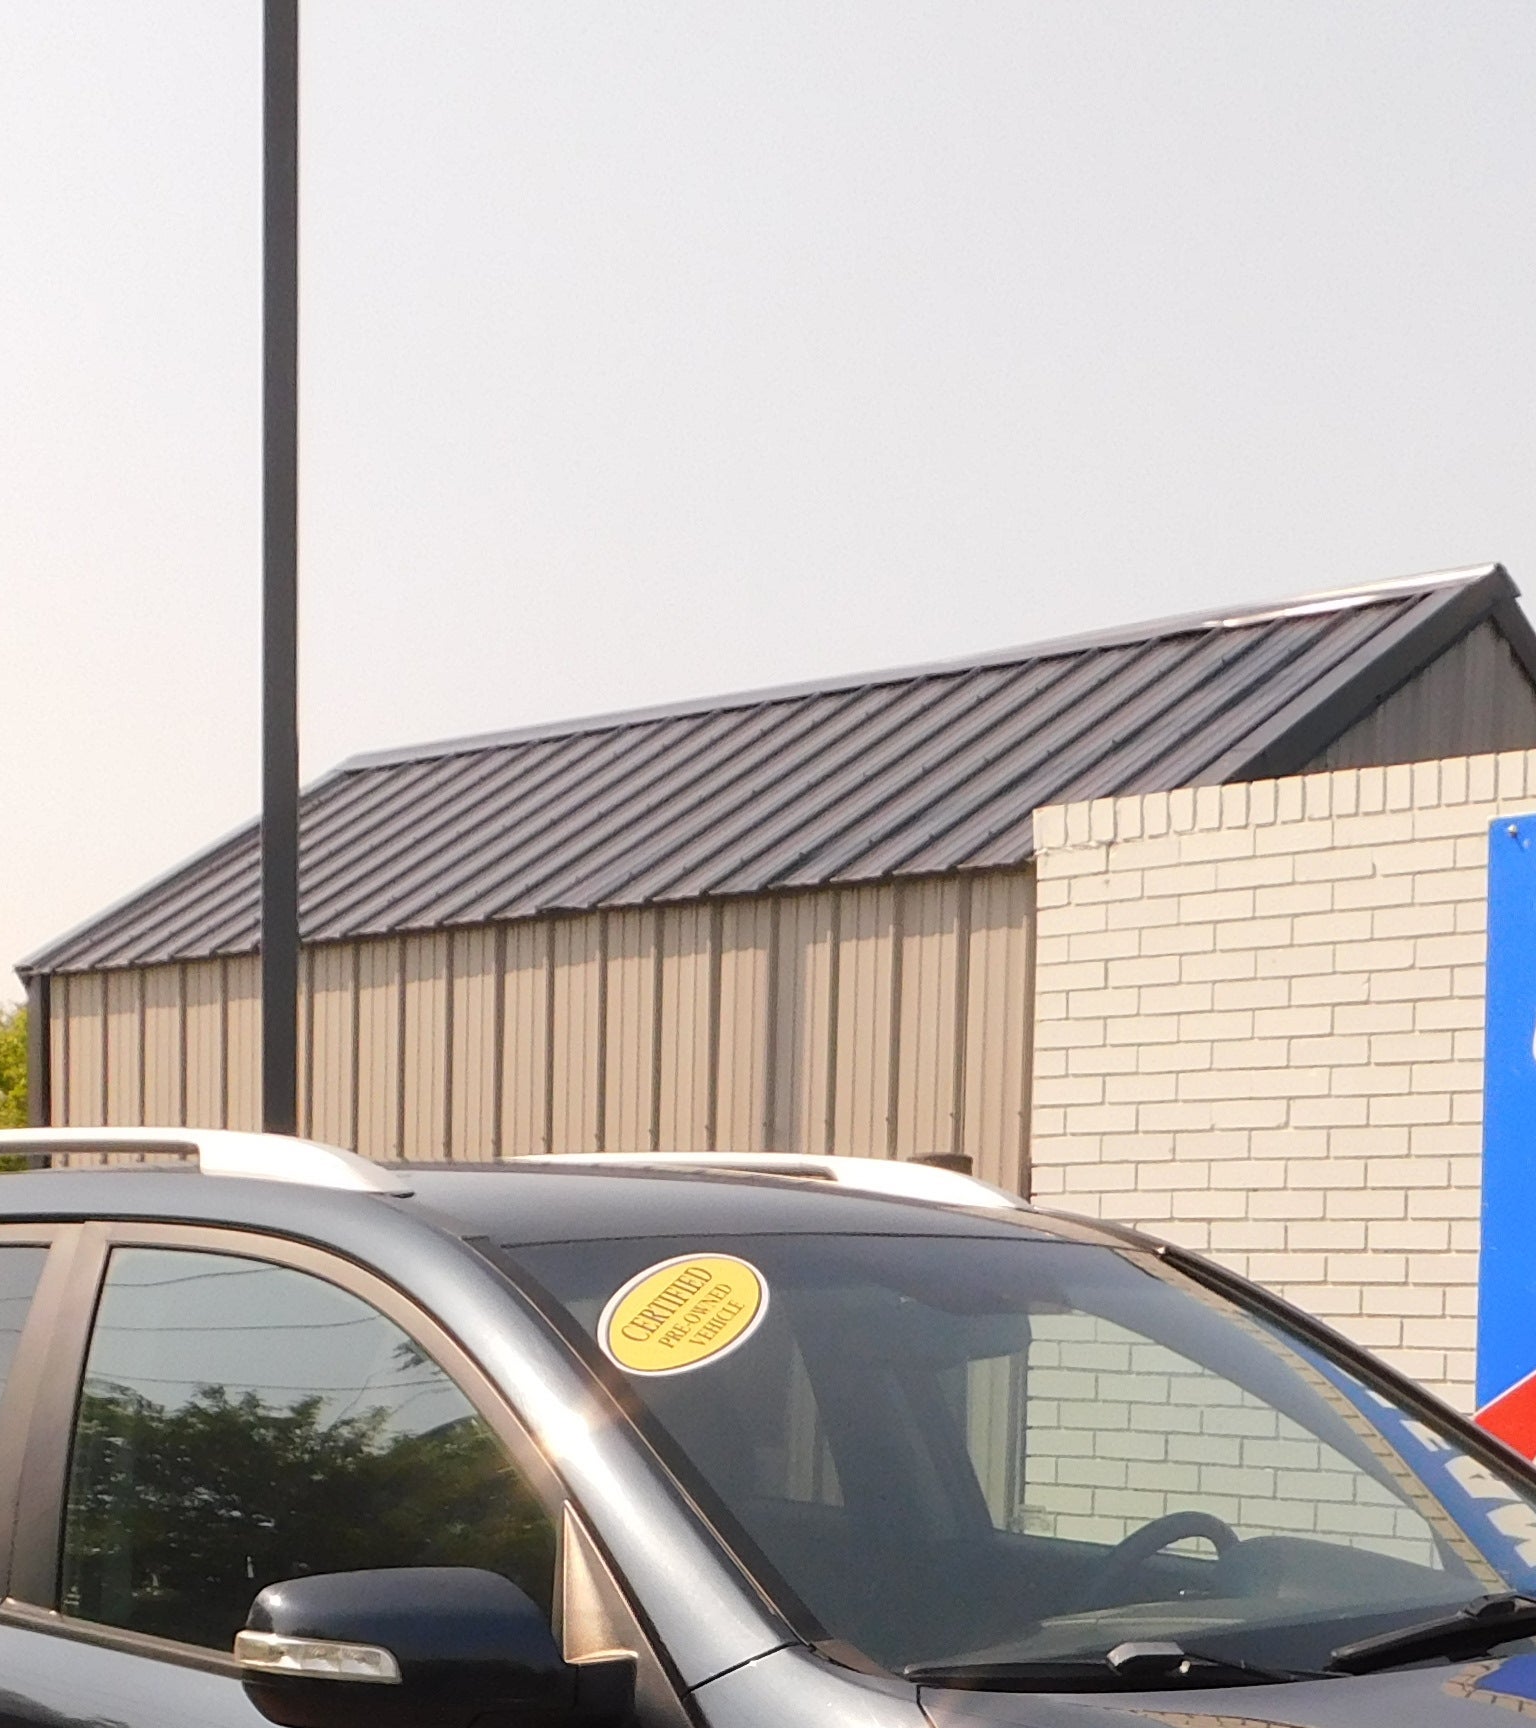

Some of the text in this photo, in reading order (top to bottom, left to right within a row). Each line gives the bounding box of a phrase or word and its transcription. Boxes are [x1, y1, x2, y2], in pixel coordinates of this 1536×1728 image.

[621, 1266, 713, 1342] CERTIFIED
[658, 1283, 732, 1349] PRE-OWNED
[688, 1300, 745, 1347] VEHICLE
